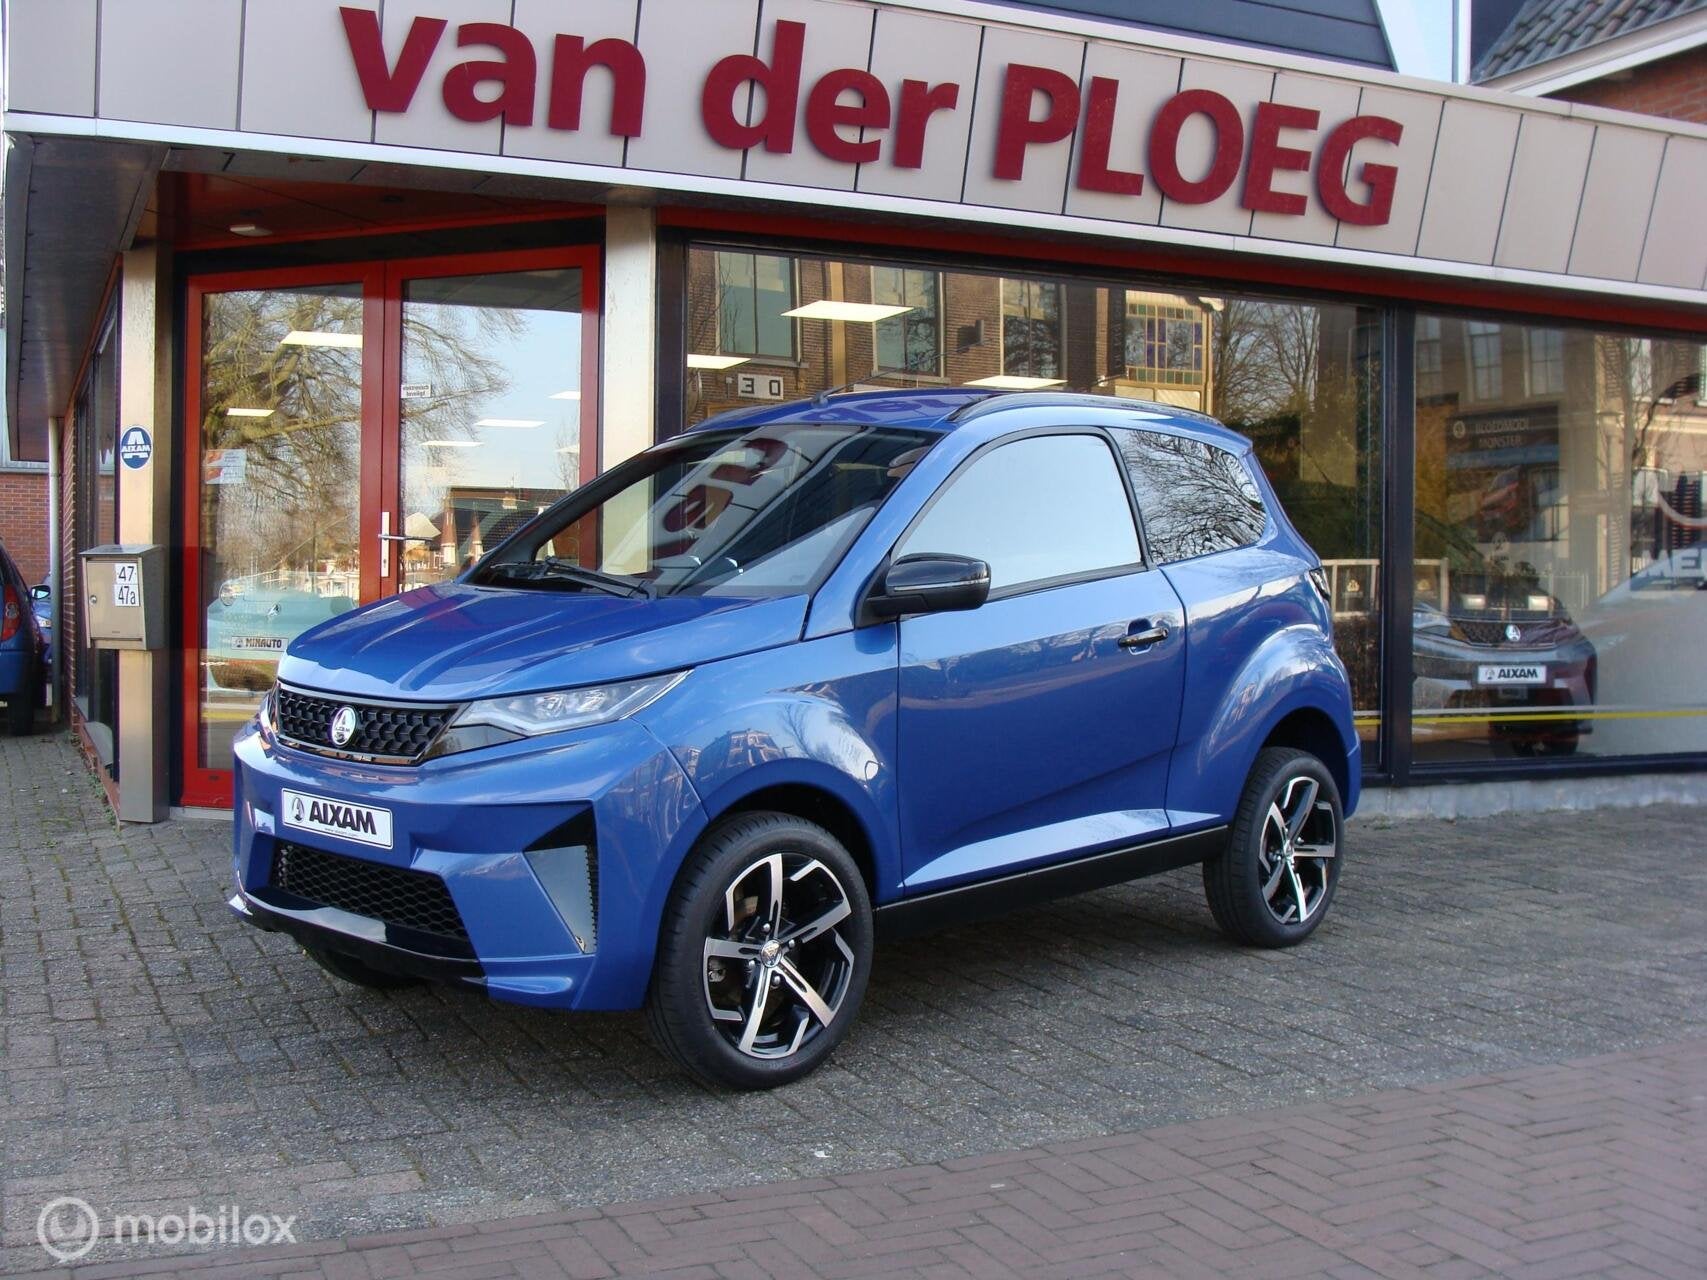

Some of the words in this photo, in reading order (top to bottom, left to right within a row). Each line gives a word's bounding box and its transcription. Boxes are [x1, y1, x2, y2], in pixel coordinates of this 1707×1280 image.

[340, 7, 646, 138] van
[702, 19, 959, 170] der
[993, 62, 1404, 226] PLOEG
[118, 565, 135, 582] 47
[118, 585, 136, 605] 47a
[245, 637, 282, 648] MINAUTO
[1498, 668, 1538, 679] AIXAM
[309, 800, 377, 835] AIXAM
